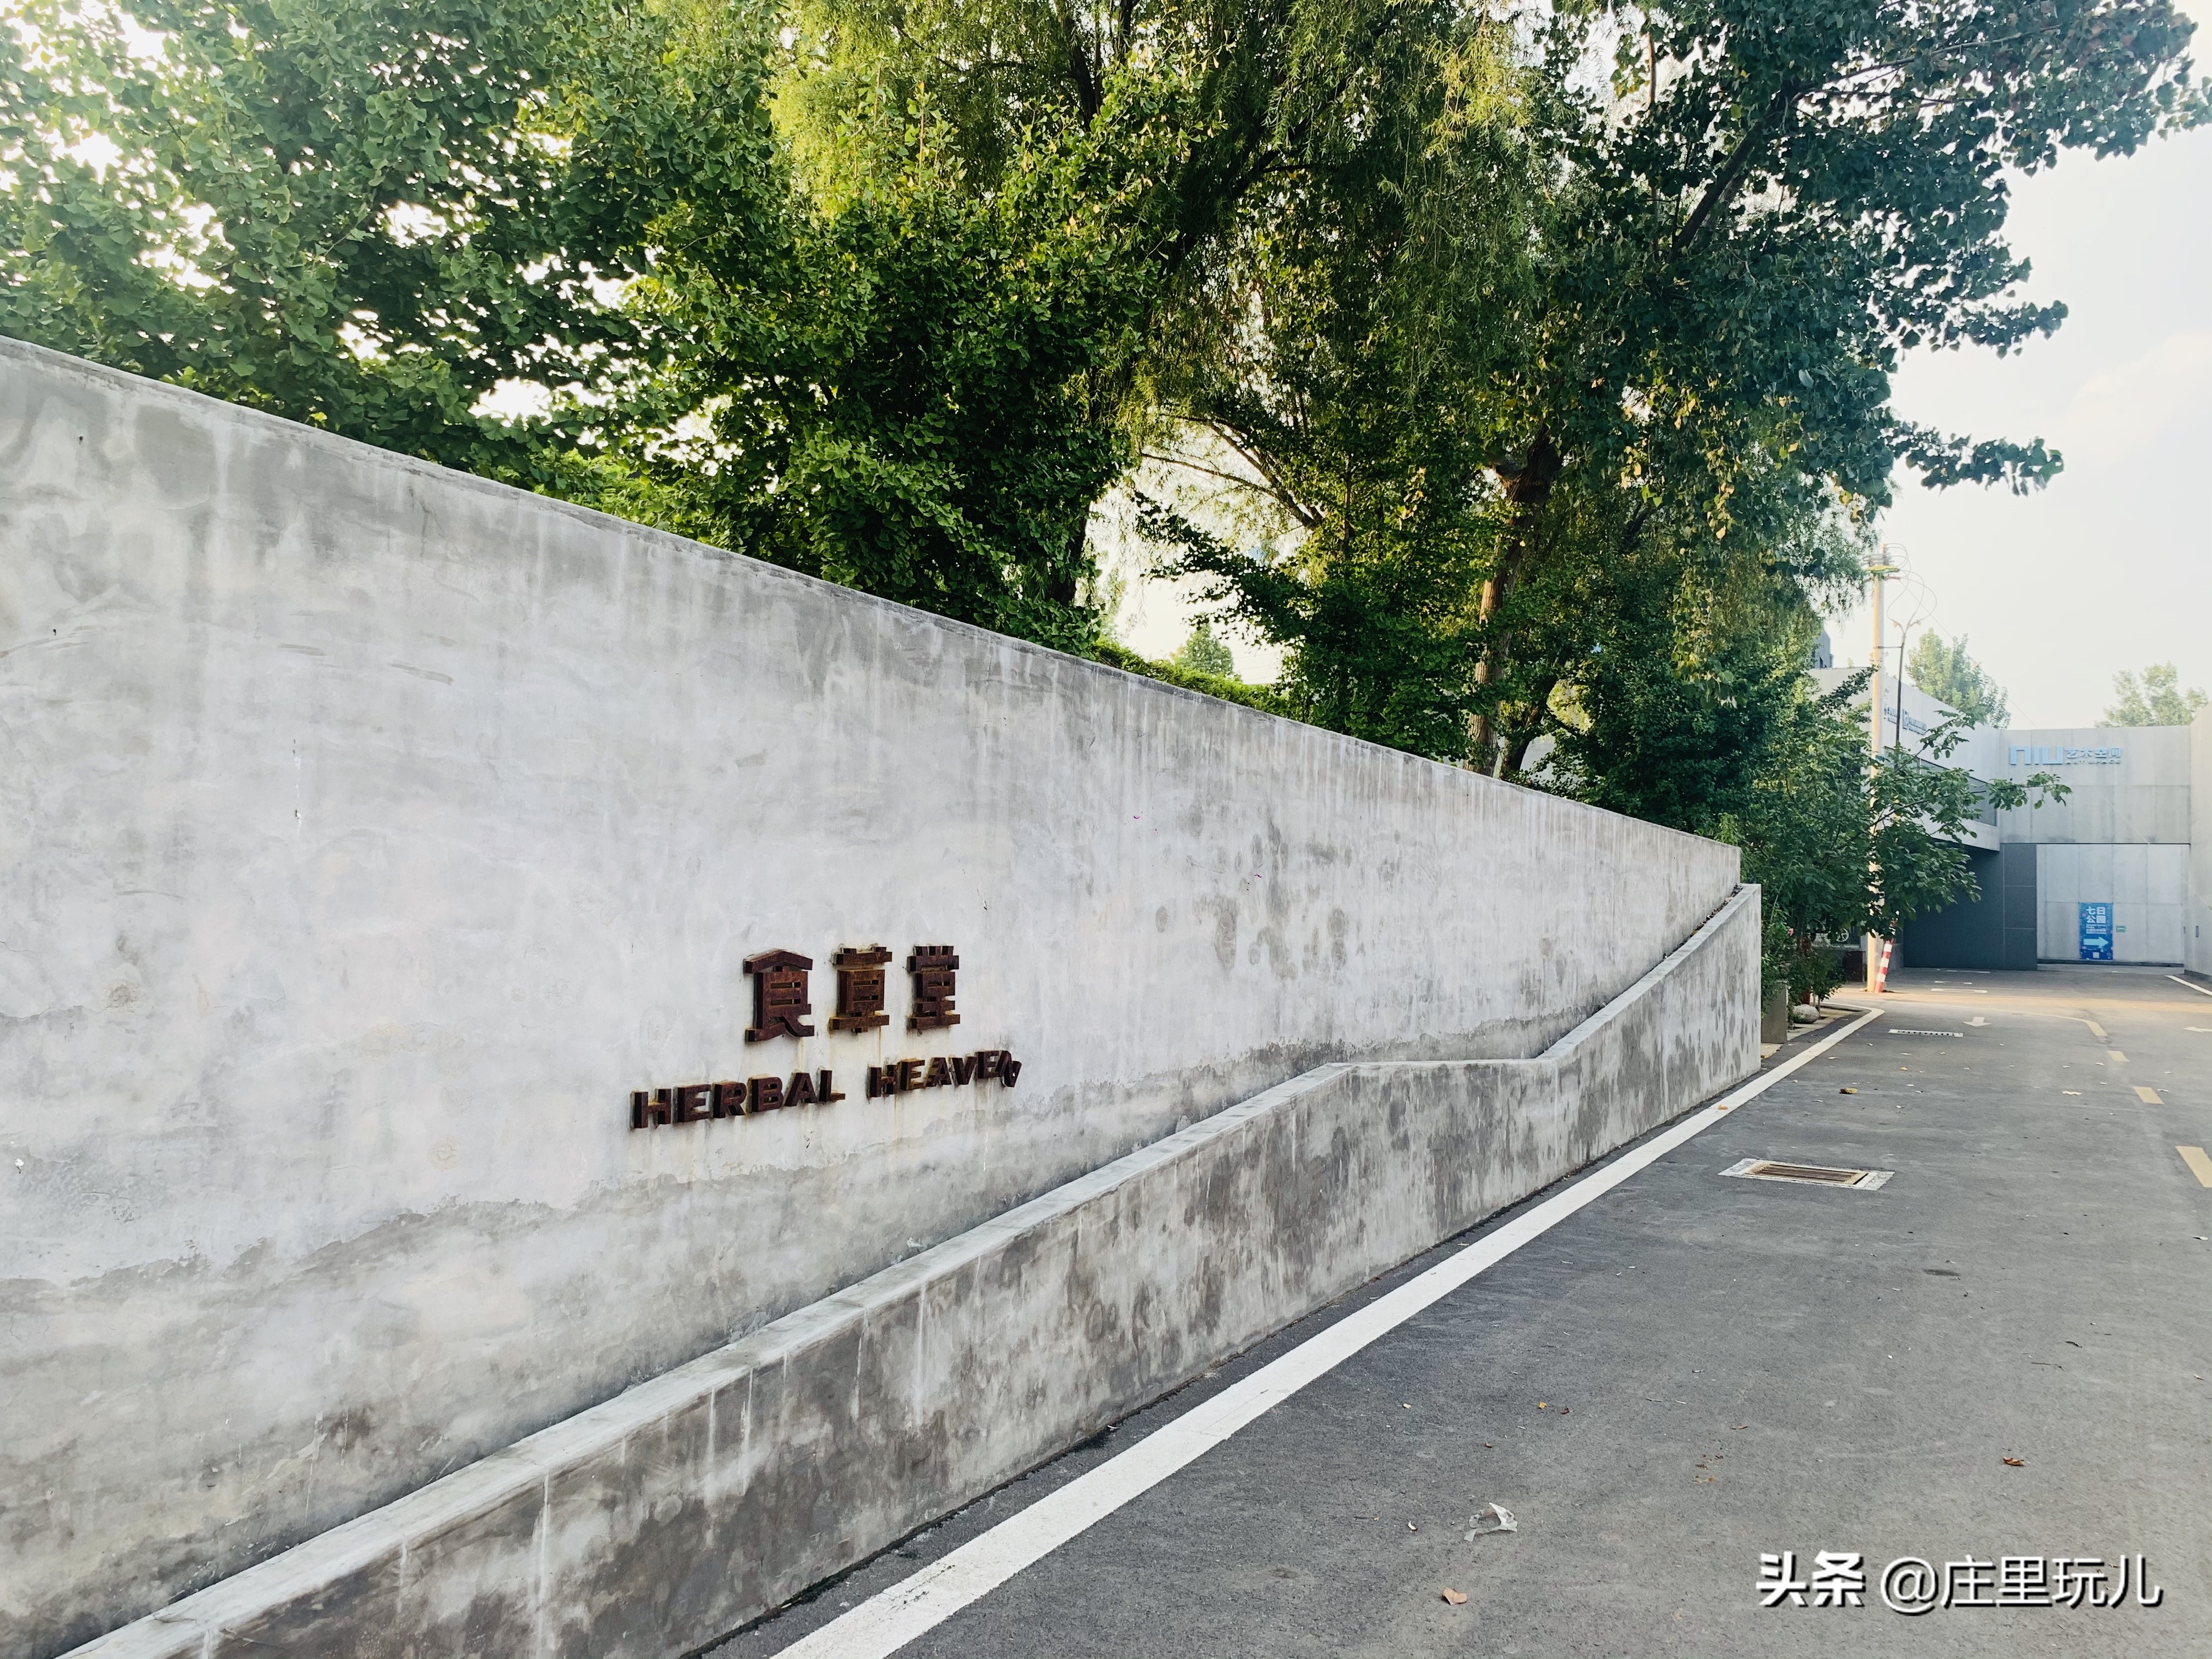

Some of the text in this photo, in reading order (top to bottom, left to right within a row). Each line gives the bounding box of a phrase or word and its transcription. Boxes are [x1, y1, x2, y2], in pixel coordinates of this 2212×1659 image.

[2066, 747, 2121, 759] 艺术空间
[2086, 906, 2106, 915] 七日
[632, 1049, 1022, 1129] HERBAL HEAVEN
